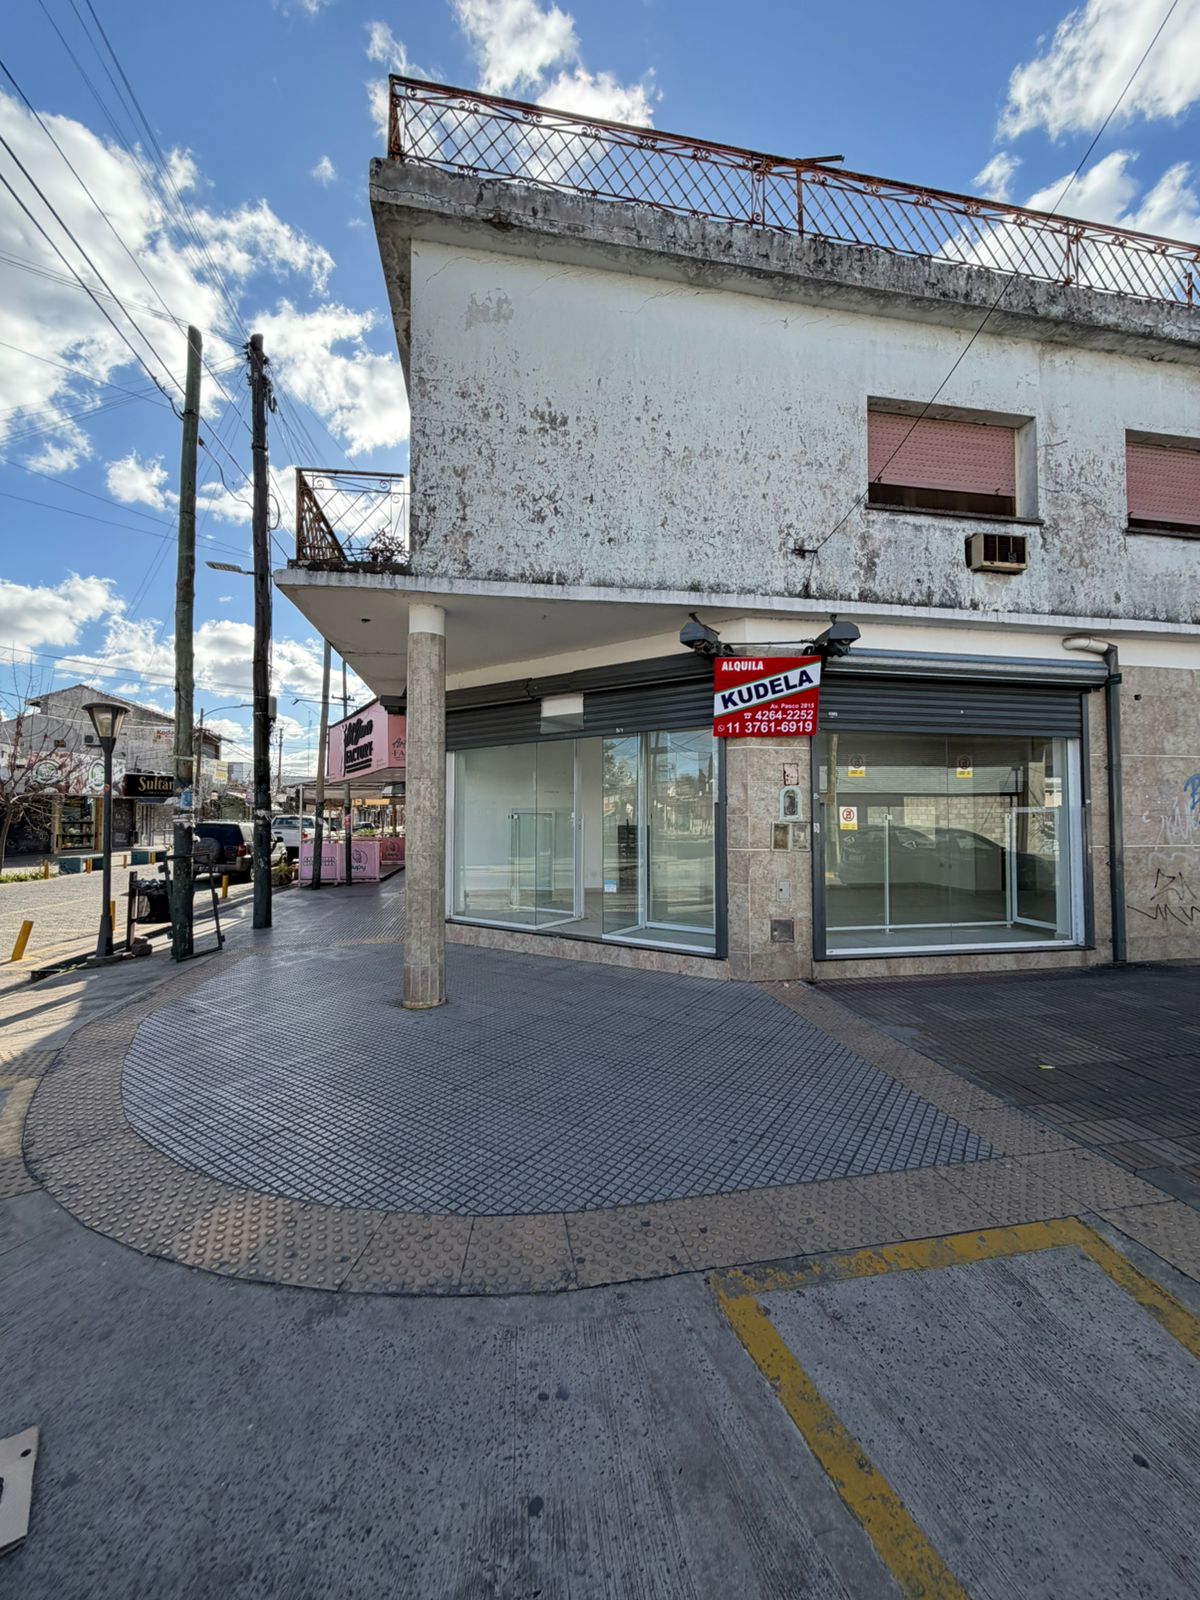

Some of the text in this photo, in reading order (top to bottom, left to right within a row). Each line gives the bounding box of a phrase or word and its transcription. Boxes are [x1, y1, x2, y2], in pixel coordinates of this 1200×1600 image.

[722, 661, 764, 671] ALQUILA
[721, 669, 814, 710] KUDELA
[755, 710, 814, 720] 4264-2252
[727, 721, 813, 734] 11 3761-6919
